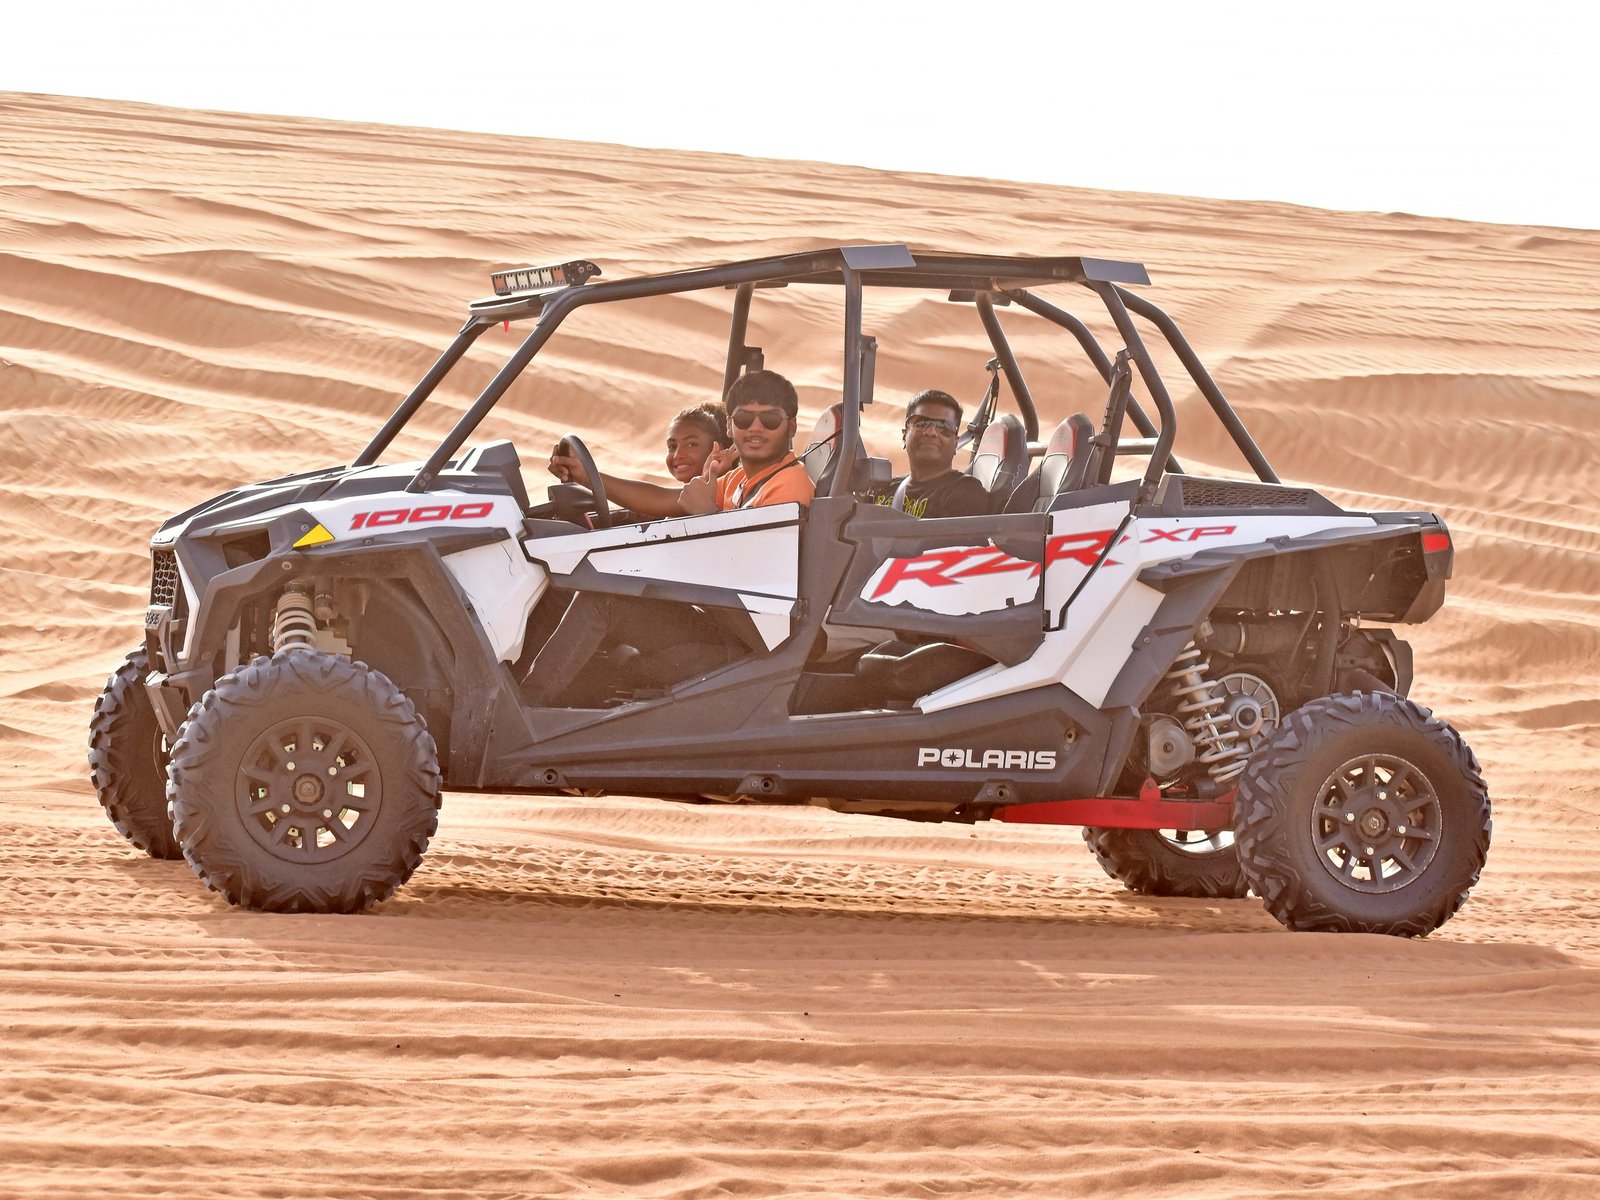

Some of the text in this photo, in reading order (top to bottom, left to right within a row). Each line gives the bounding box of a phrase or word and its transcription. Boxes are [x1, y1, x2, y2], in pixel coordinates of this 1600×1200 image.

[349, 503, 494, 531] 1000
[870, 525, 1238, 601] RZR XP
[917, 747, 1057, 770] POLARIS
